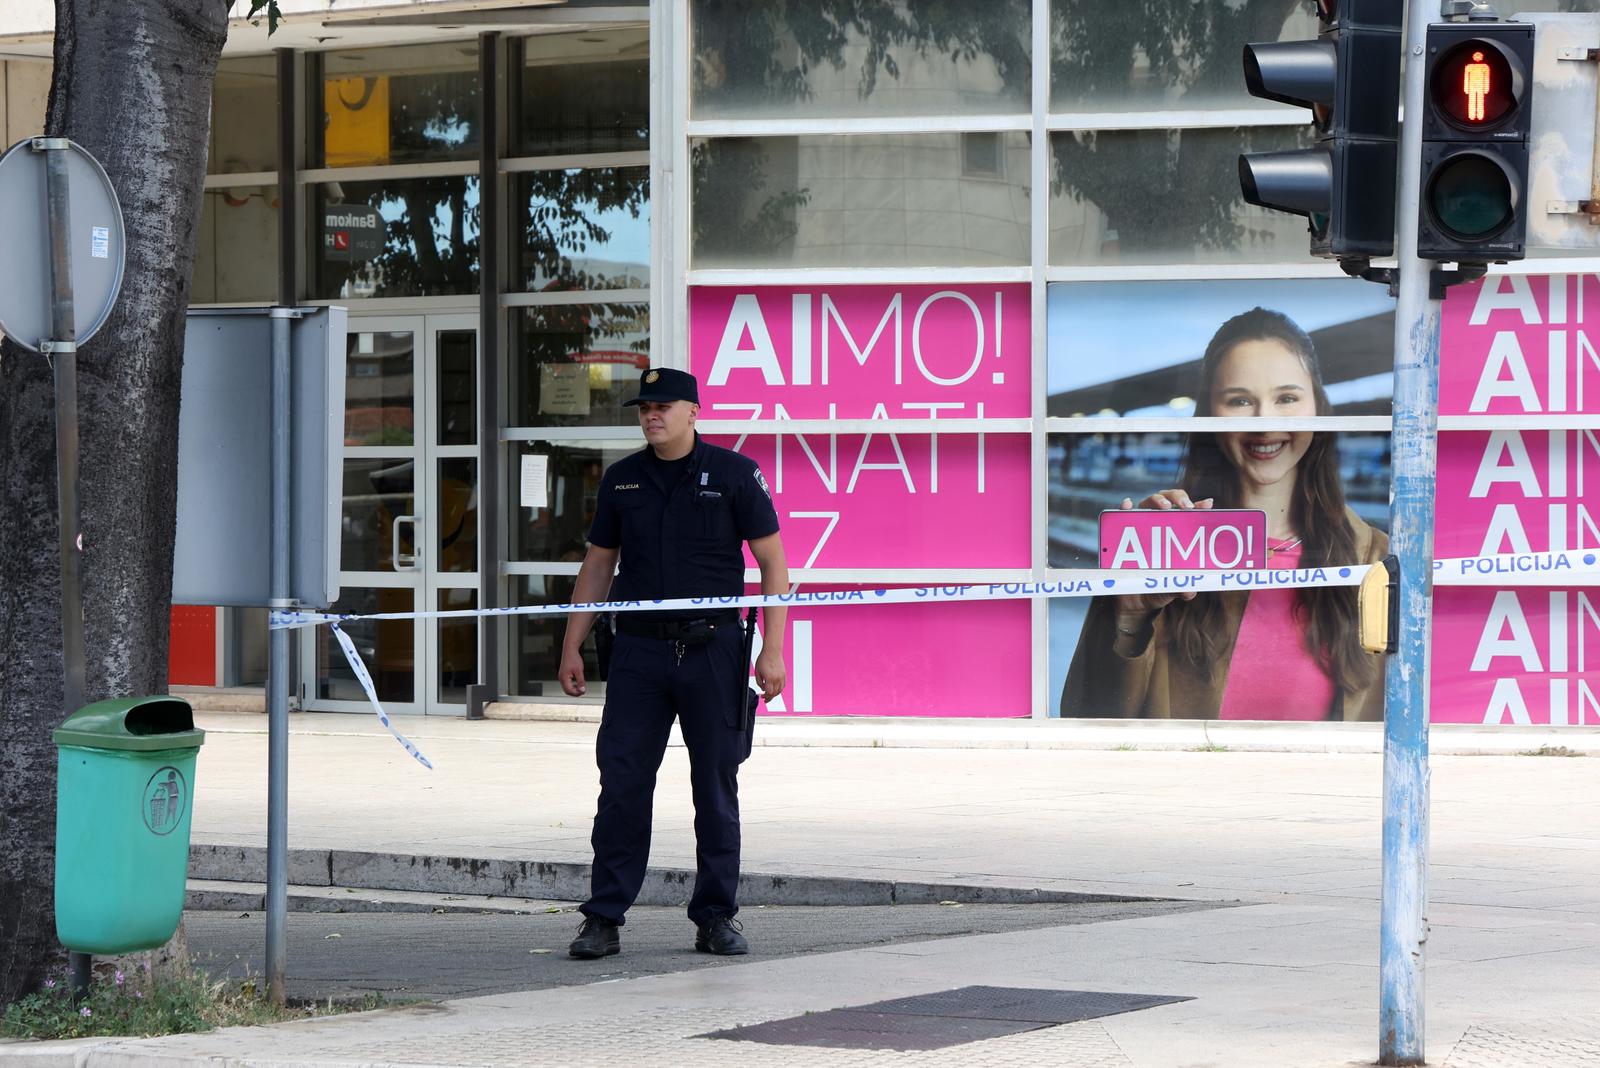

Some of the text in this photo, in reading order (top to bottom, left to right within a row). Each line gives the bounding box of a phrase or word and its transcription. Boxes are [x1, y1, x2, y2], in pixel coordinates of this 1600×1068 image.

[706, 290, 1004, 386] AIMO!
[614, 483, 640, 491] POLICIJA
[1110, 524, 1254, 569] AIMO!
[1479, 503, 1600, 558] AI
[1221, 568, 1328, 586] POLICIJA
[1460, 553, 1571, 575] POLICIJA
[1482, 677, 1600, 725] AI
